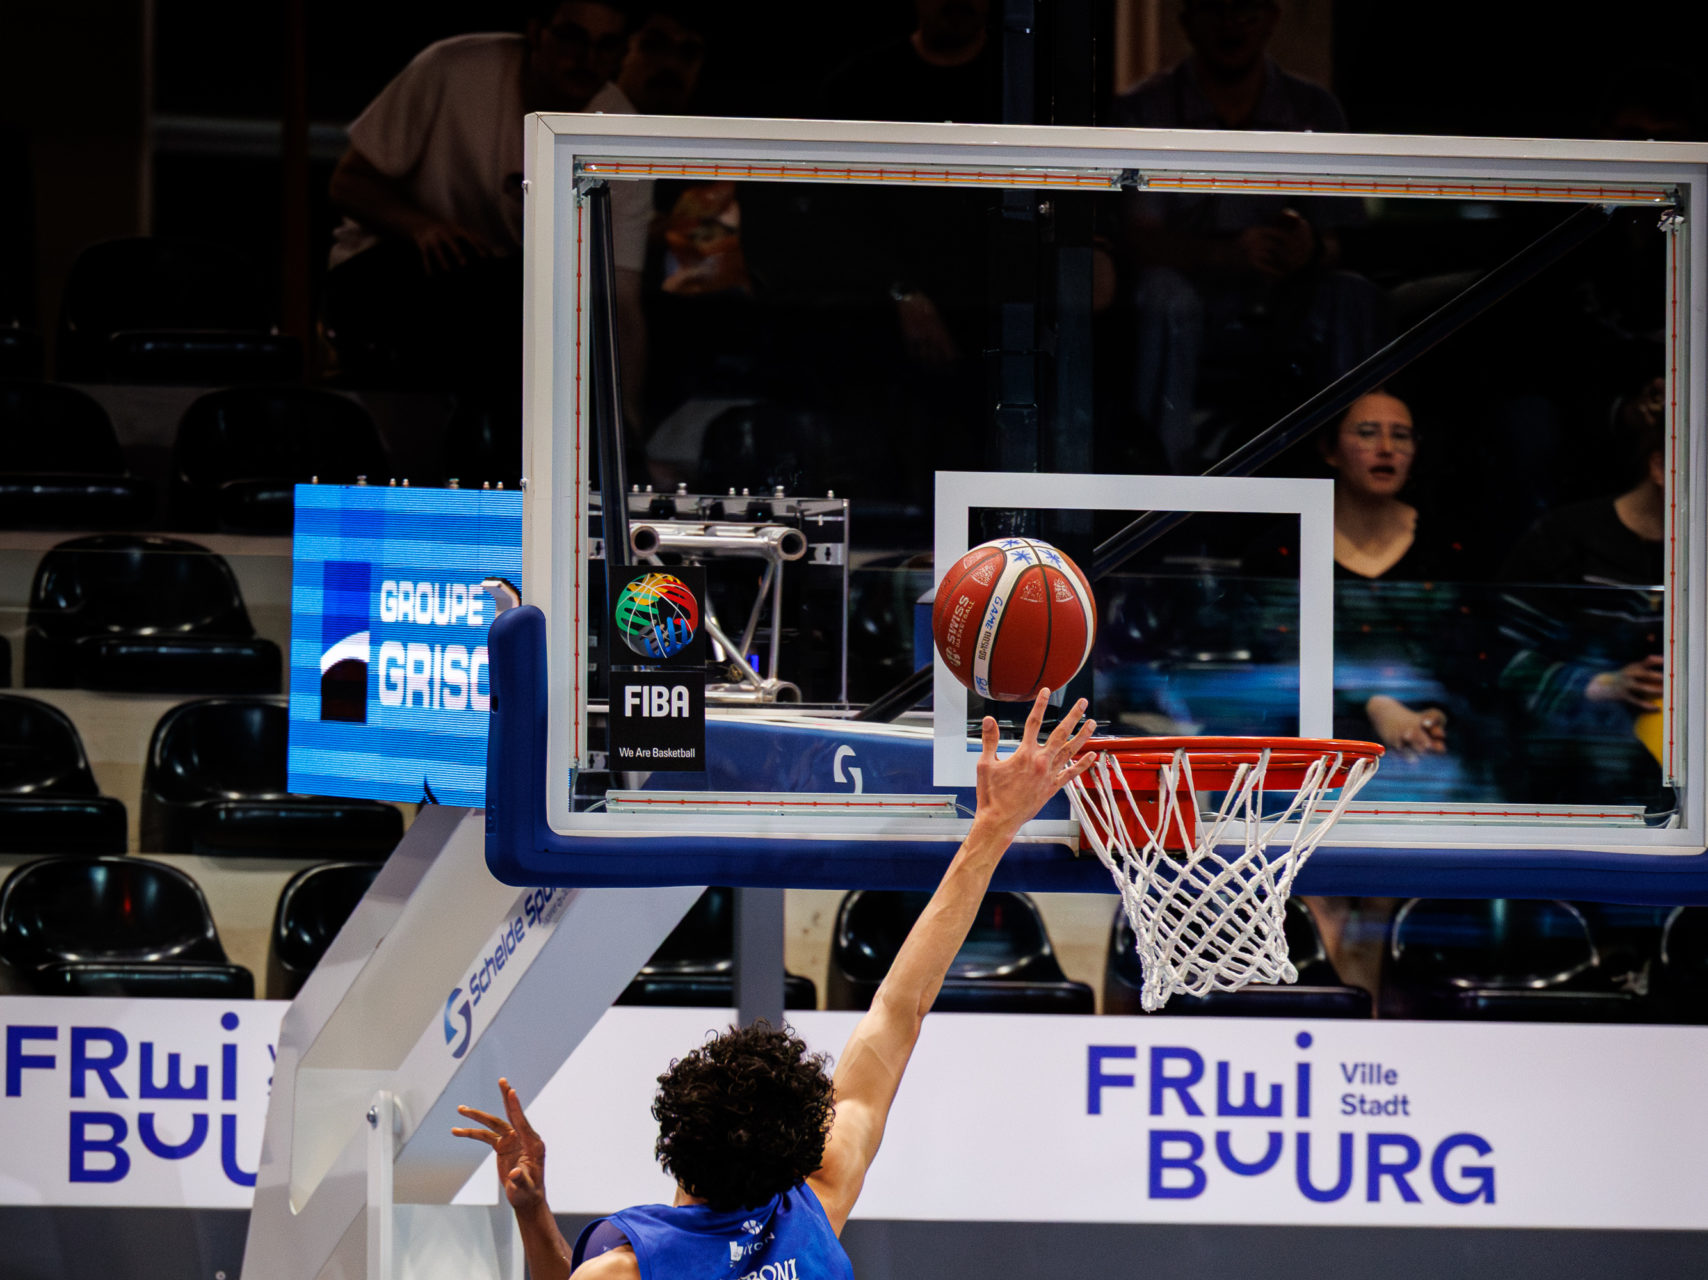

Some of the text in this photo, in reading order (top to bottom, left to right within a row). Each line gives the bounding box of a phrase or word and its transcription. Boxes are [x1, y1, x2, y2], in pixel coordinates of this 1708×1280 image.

[380, 580, 484, 626] GROUPE
[947, 595, 969, 644] SWISS
[624, 685, 690, 718] FIBA
[619, 746, 696, 759] We Are Basketball
[469, 887, 556, 1007] Schelde Spo
[1340, 1062, 1399, 1086] Ville
[1340, 1093, 1411, 1117] Stadt
